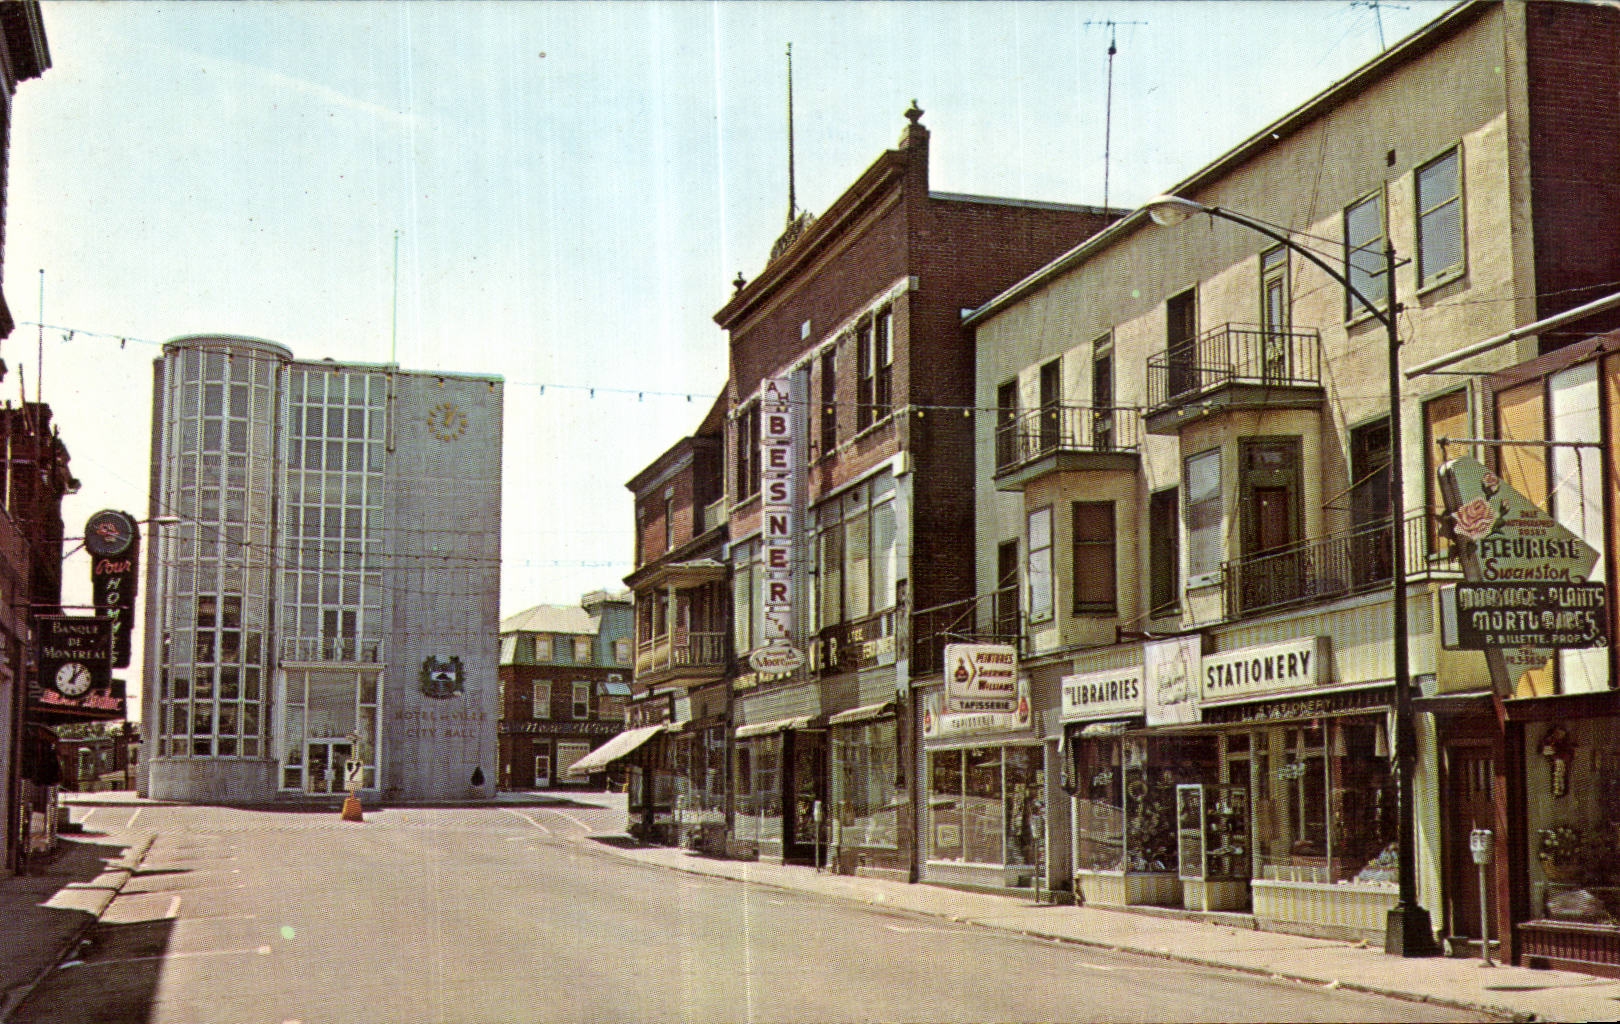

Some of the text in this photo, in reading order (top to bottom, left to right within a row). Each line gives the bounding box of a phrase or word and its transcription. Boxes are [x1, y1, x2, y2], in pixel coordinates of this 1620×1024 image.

[769, 415, 787, 601] BESNER
[1481, 537, 1580, 559] FLEURISTE
[1483, 558, 1586, 581] Swanston
[1549, 587, 1605, 607] PLANTS
[53, 621, 98, 634] BANQUE
[1473, 610, 1599, 640] MORTUAIRES
[44, 646, 106, 659] MONTREAL
[1206, 650, 1311, 689] STATIONERY
[1071, 677, 1139, 706] LIBRAIRIES
[959, 701, 1010, 710] TAPISSERIE
